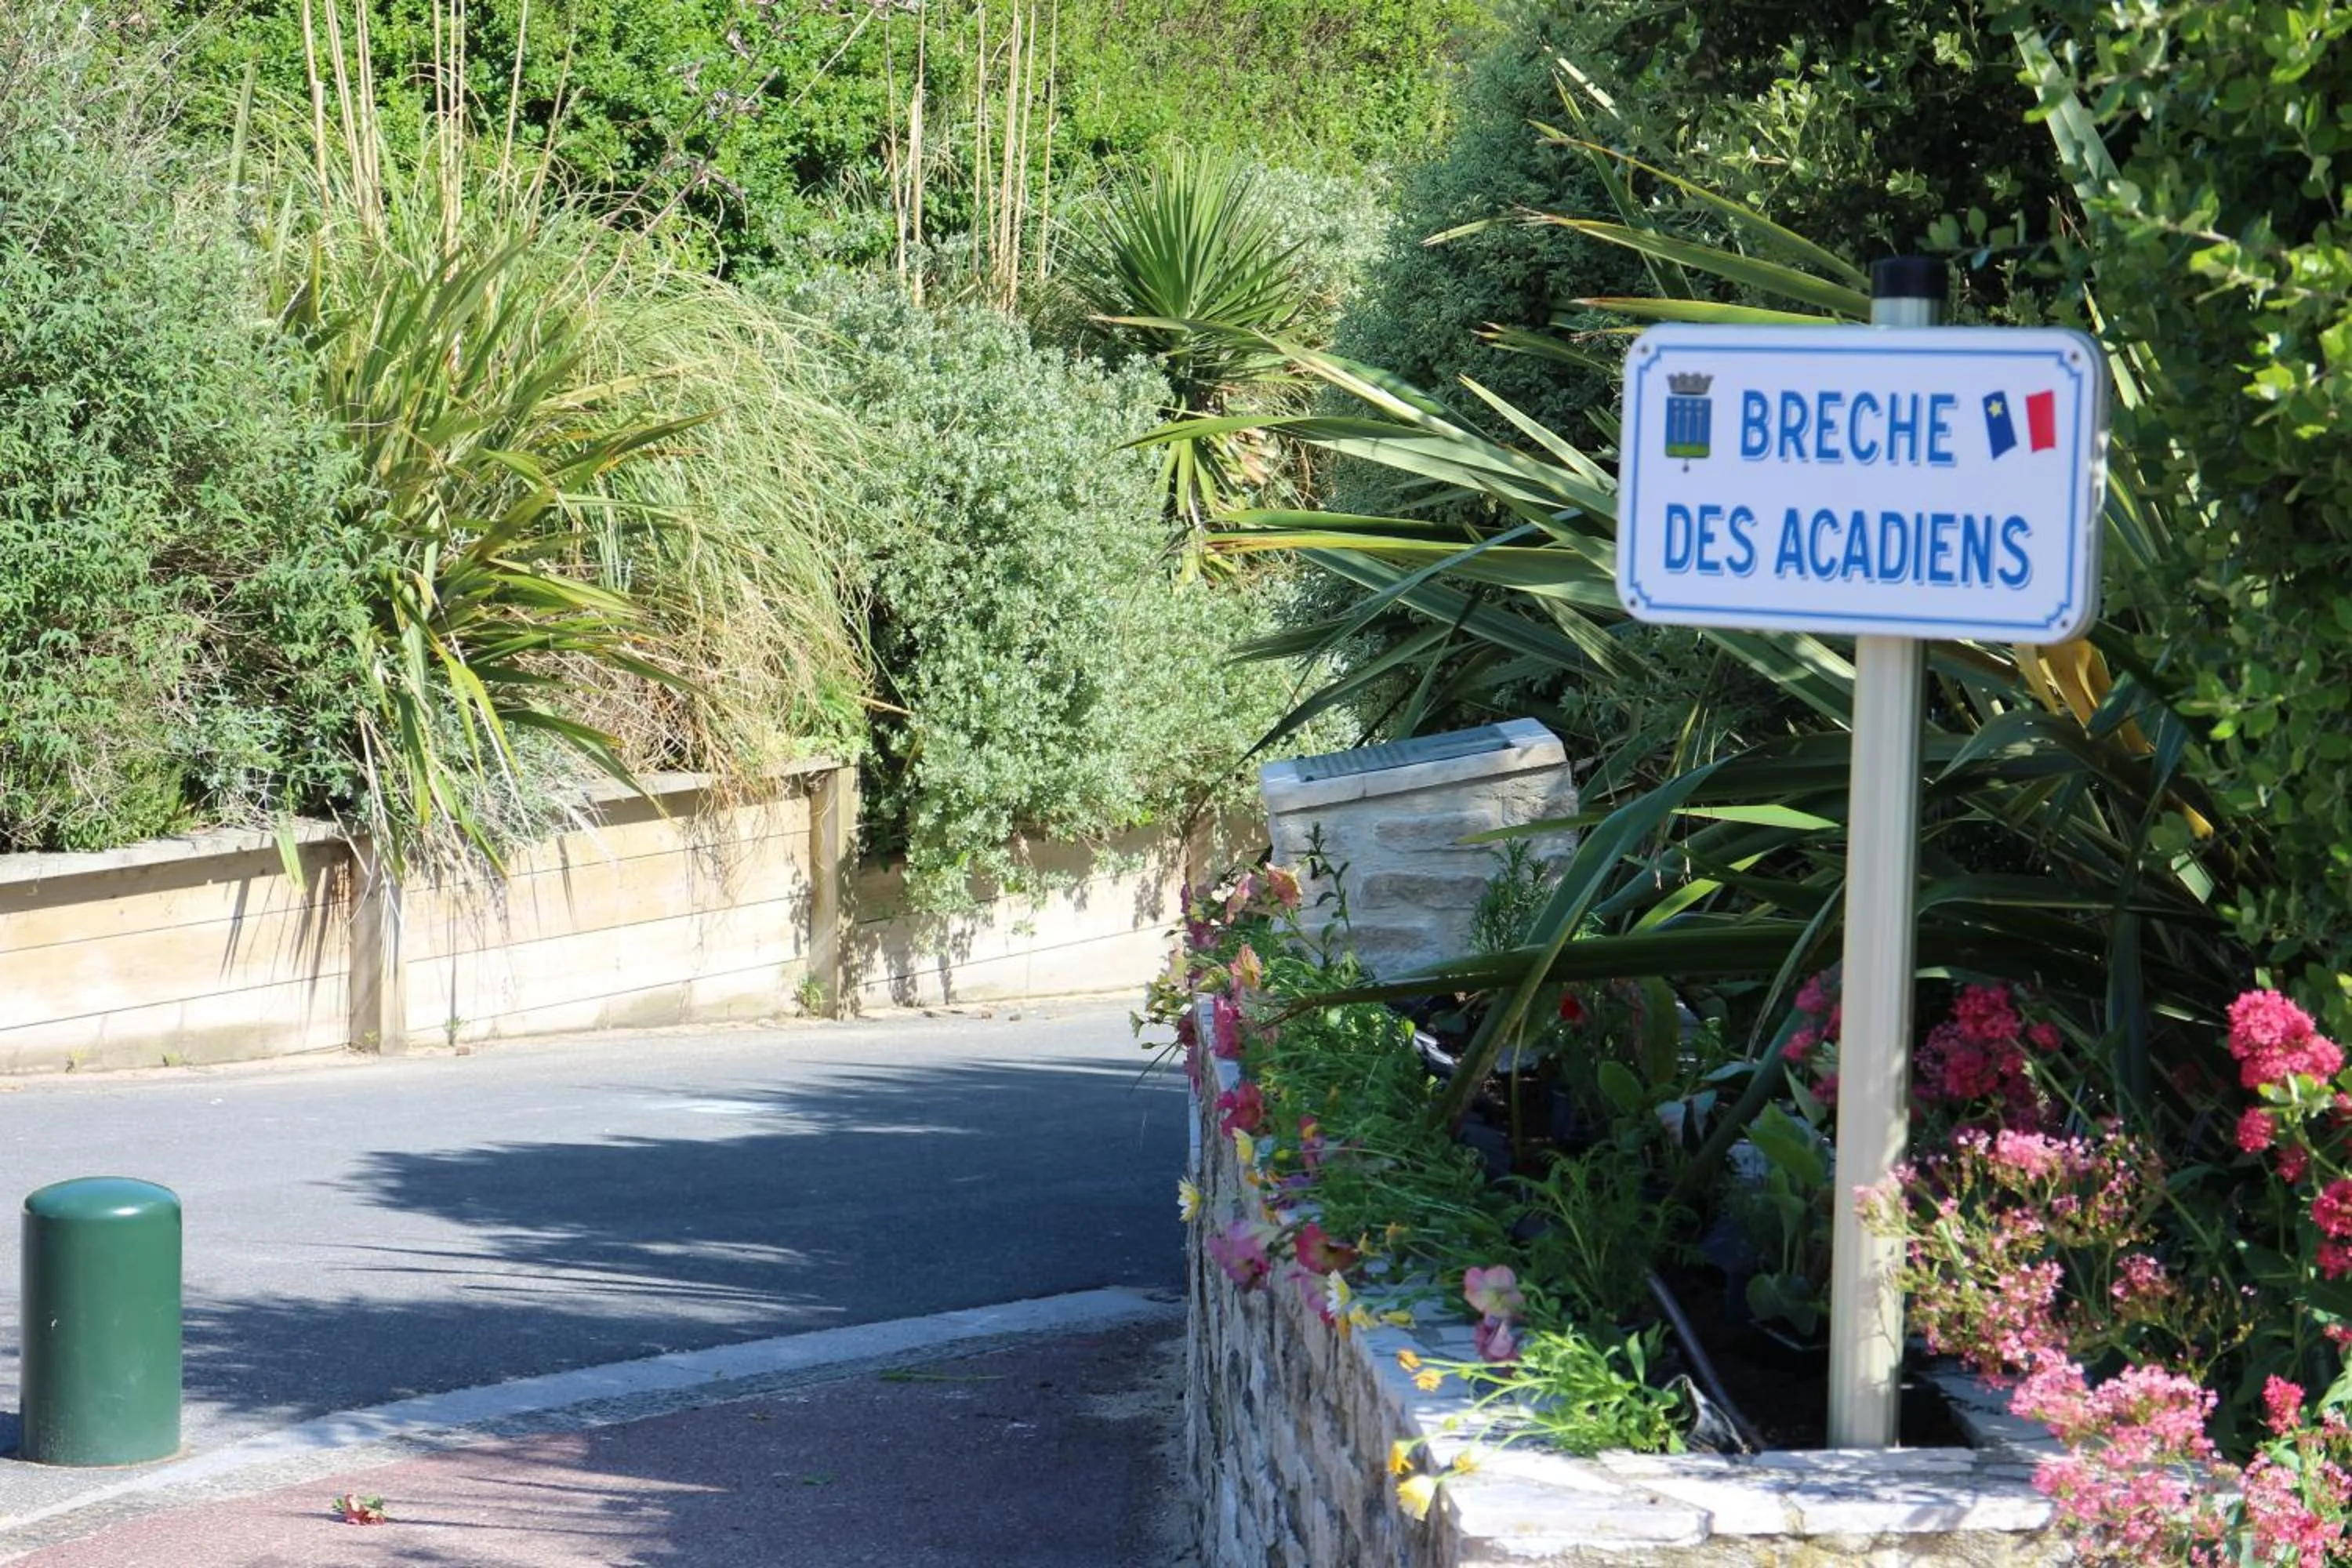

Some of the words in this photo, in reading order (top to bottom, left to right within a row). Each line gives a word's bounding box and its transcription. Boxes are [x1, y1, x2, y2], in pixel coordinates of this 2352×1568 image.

[1740, 390, 1958, 466] BRECHE
[1664, 503, 1758, 576] DES
[1774, 508, 2032, 589] ACADIENS
